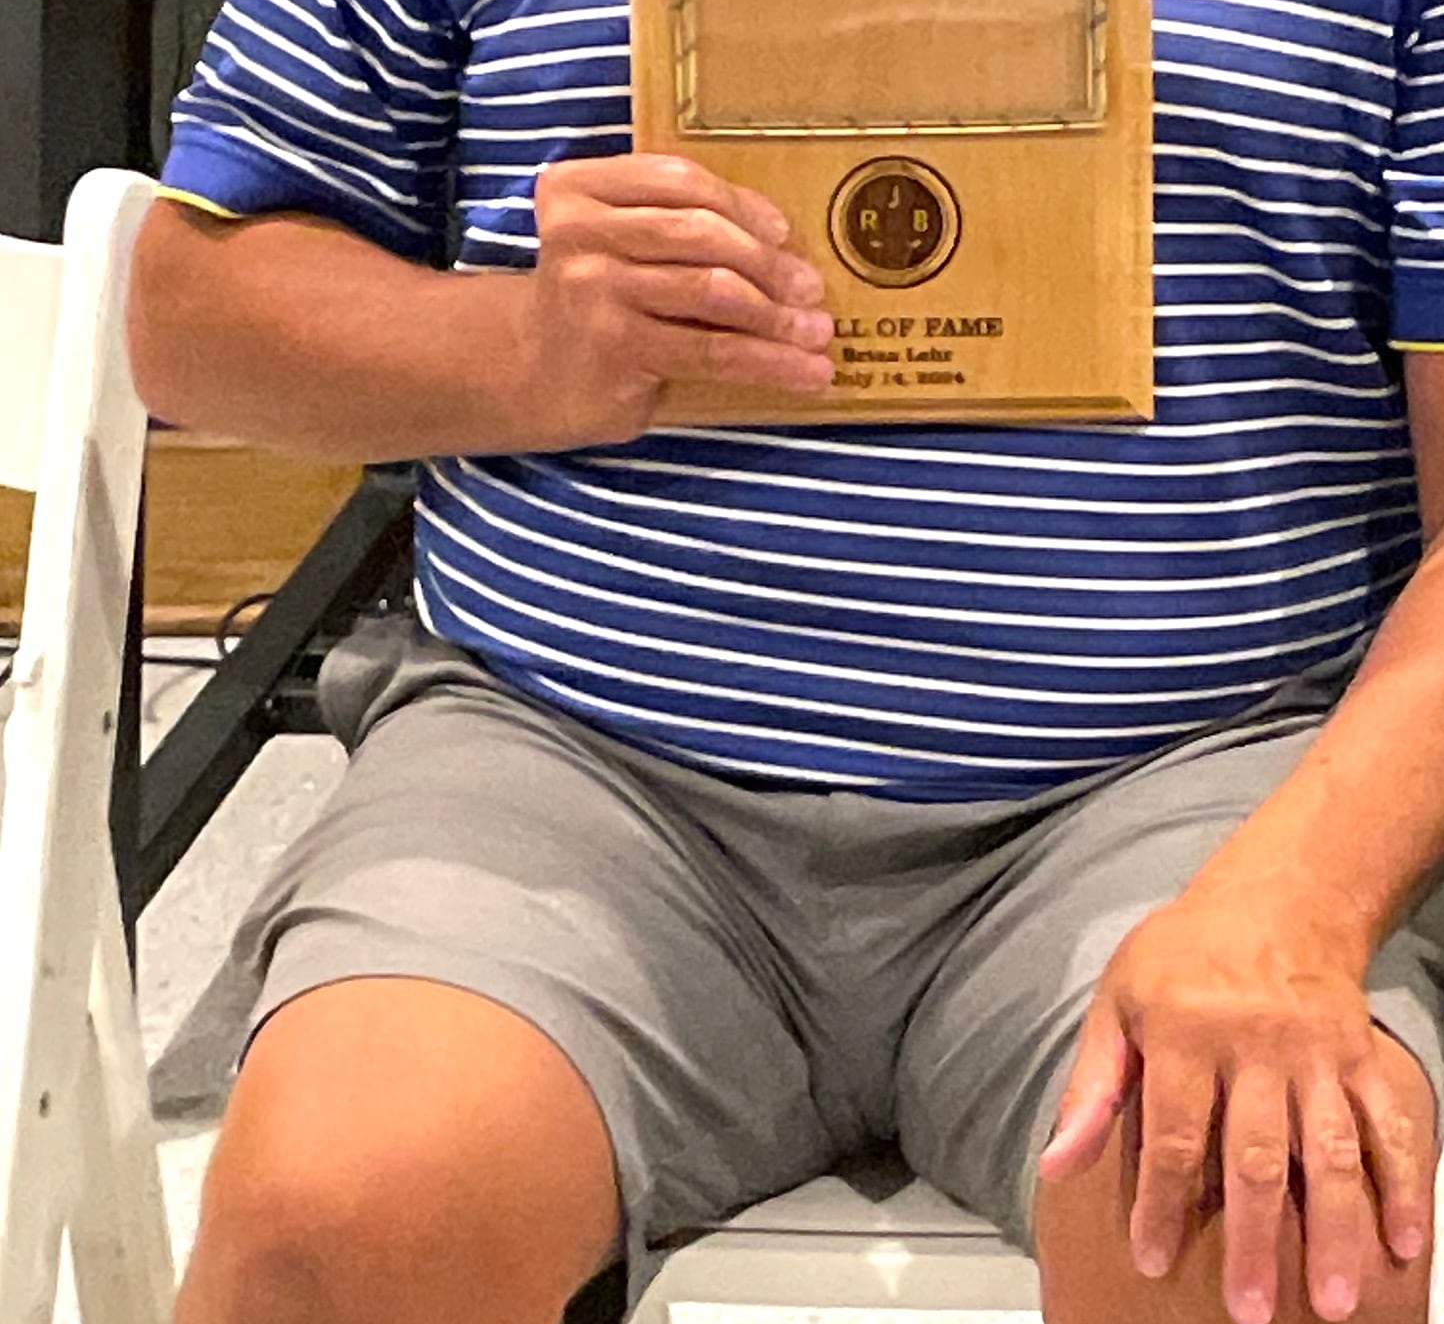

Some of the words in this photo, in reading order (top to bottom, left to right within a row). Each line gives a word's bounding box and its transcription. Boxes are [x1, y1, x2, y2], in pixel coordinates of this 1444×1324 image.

[859, 209, 878, 232] R
[912, 209, 929, 232] B
[834, 317, 870, 338] LL
[876, 317, 915, 338] OF
[924, 317, 1004, 338] FAME
[842, 347, 899, 363] Brian
[830, 370, 873, 389] July
[916, 371, 965, 386] 2024
